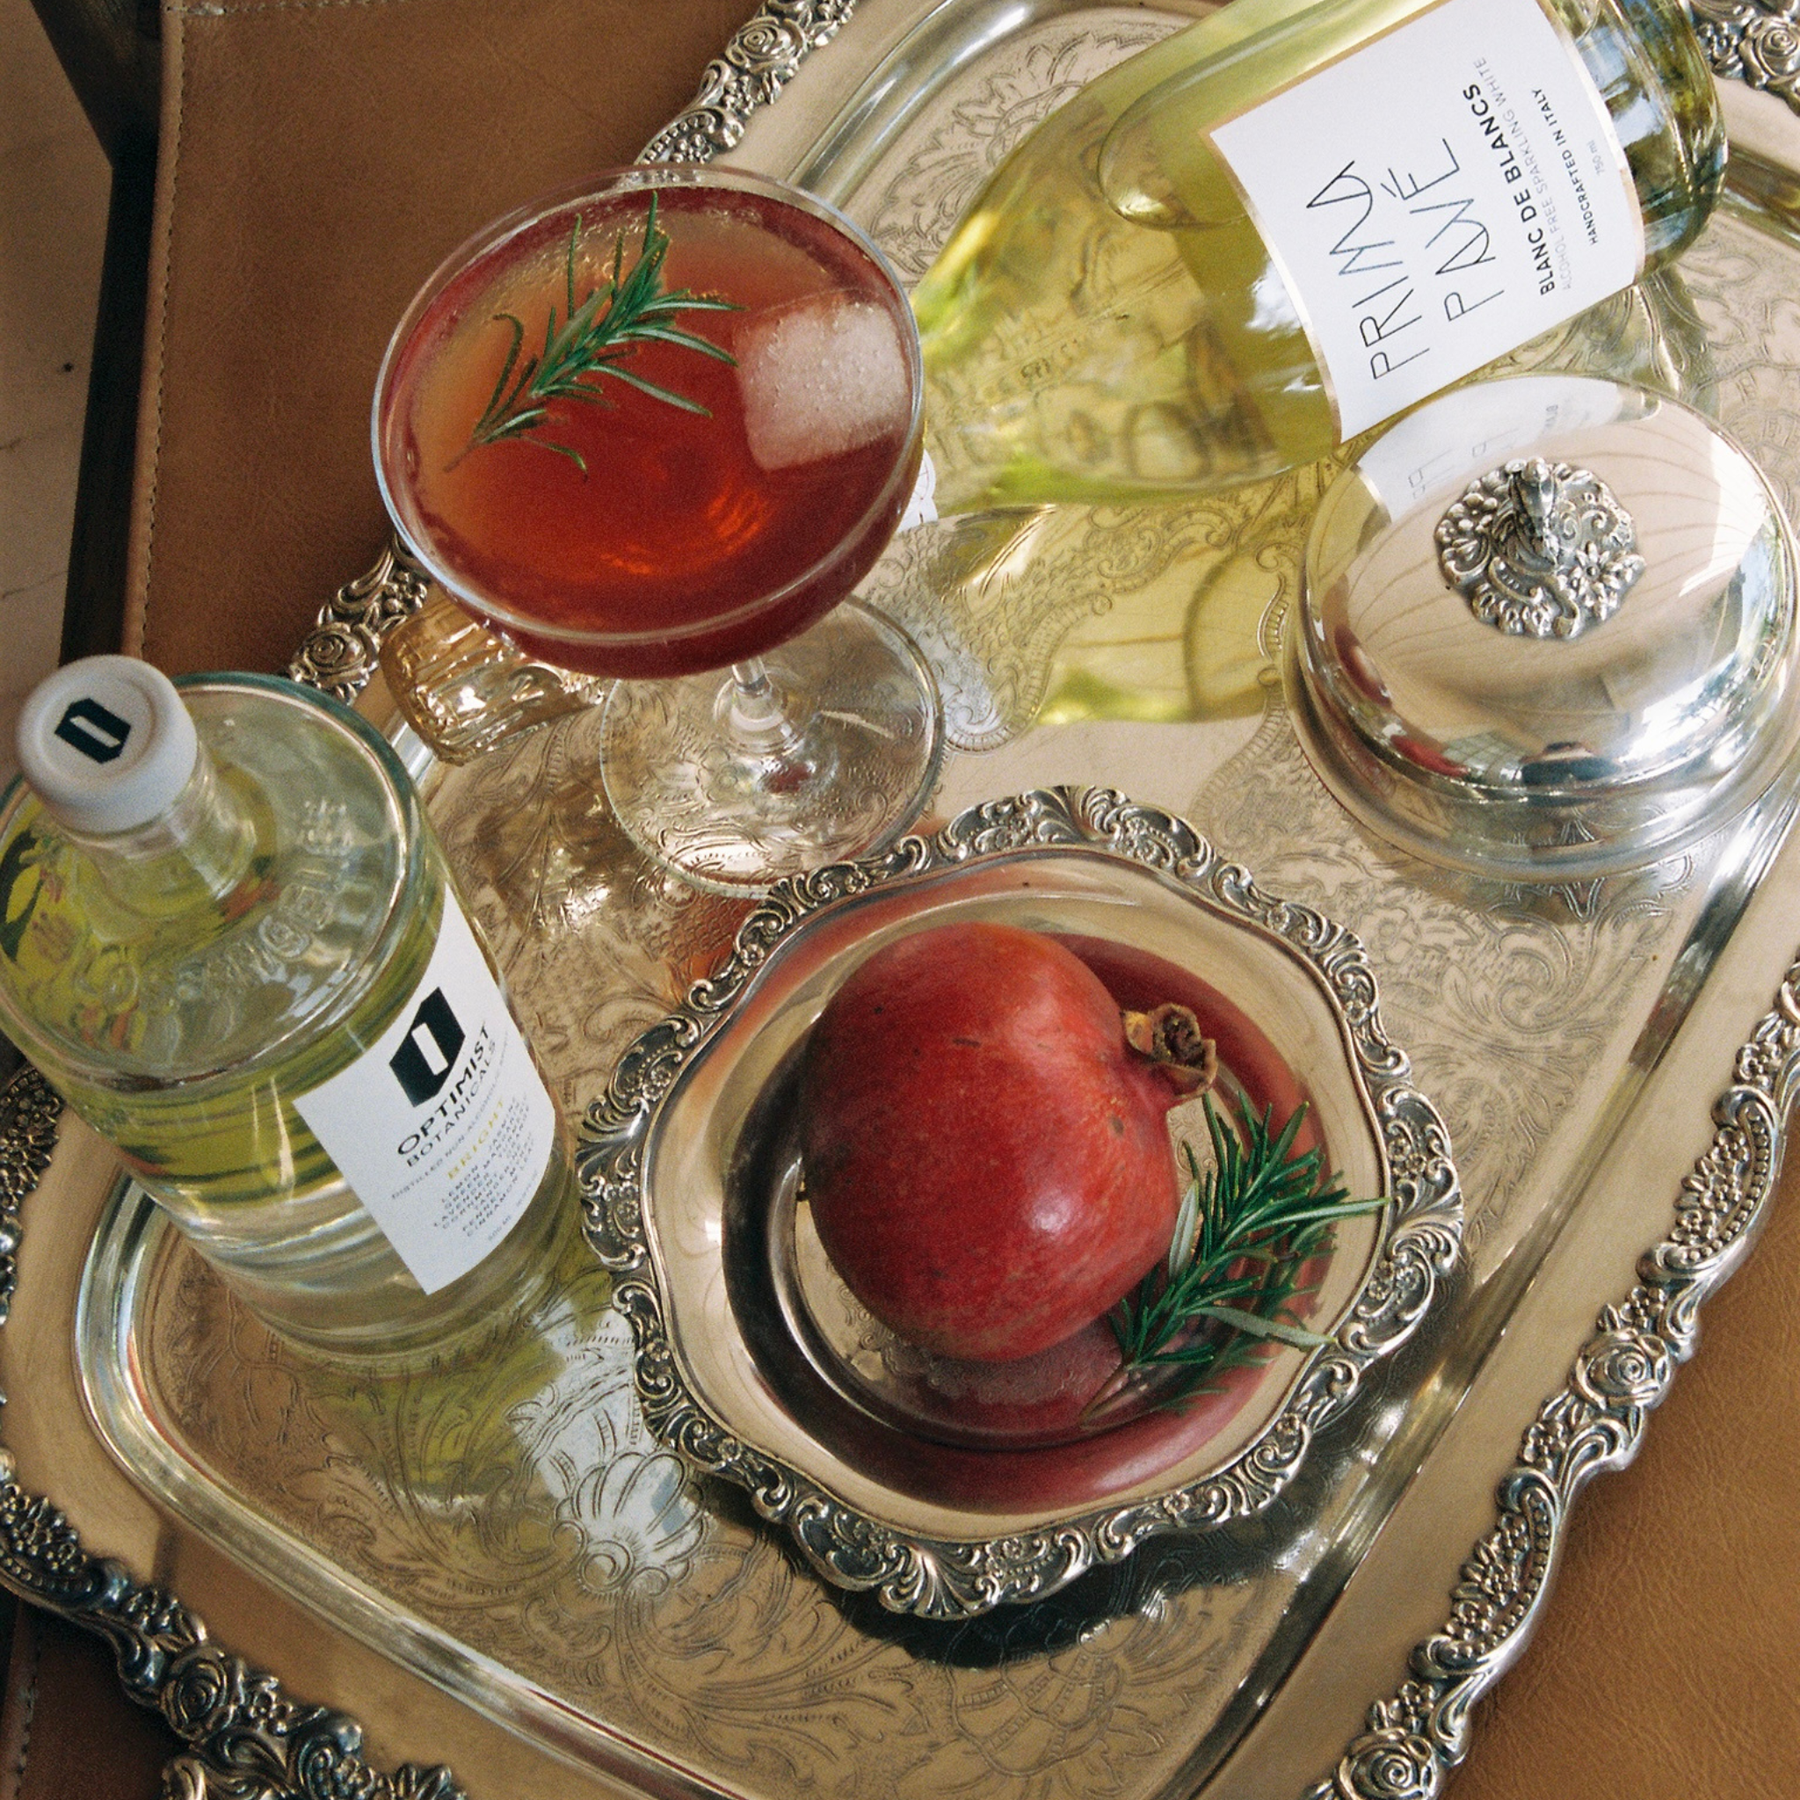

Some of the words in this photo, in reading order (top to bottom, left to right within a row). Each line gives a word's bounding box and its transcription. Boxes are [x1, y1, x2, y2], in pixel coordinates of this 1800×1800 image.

[1474, 57, 1507, 106] WHITE
[1531, 88, 1557, 127] ITALY
[1462, 84, 1522, 184] BLANCS
[1502, 110, 1548, 194] SPARKLING
[1552, 129, 1567, 147] IN
[1592, 156, 1605, 175] 750
[1513, 189, 1537, 223] DE
[1541, 196, 1560, 234] FREE
[1561, 149, 1598, 246] HANDCRAFTED
[1306, 160, 1430, 380] PRIMA
[1528, 228, 1555, 295] BLANC
[1555, 234, 1572, 291] ALCOHOL
[396, 1022, 488, 1155] OPTIMIST
[405, 1041, 495, 1167] BOTANICALS
[446, 1100, 502, 1180] BRIGHT
[441, 1164, 478, 1203] LEMON
